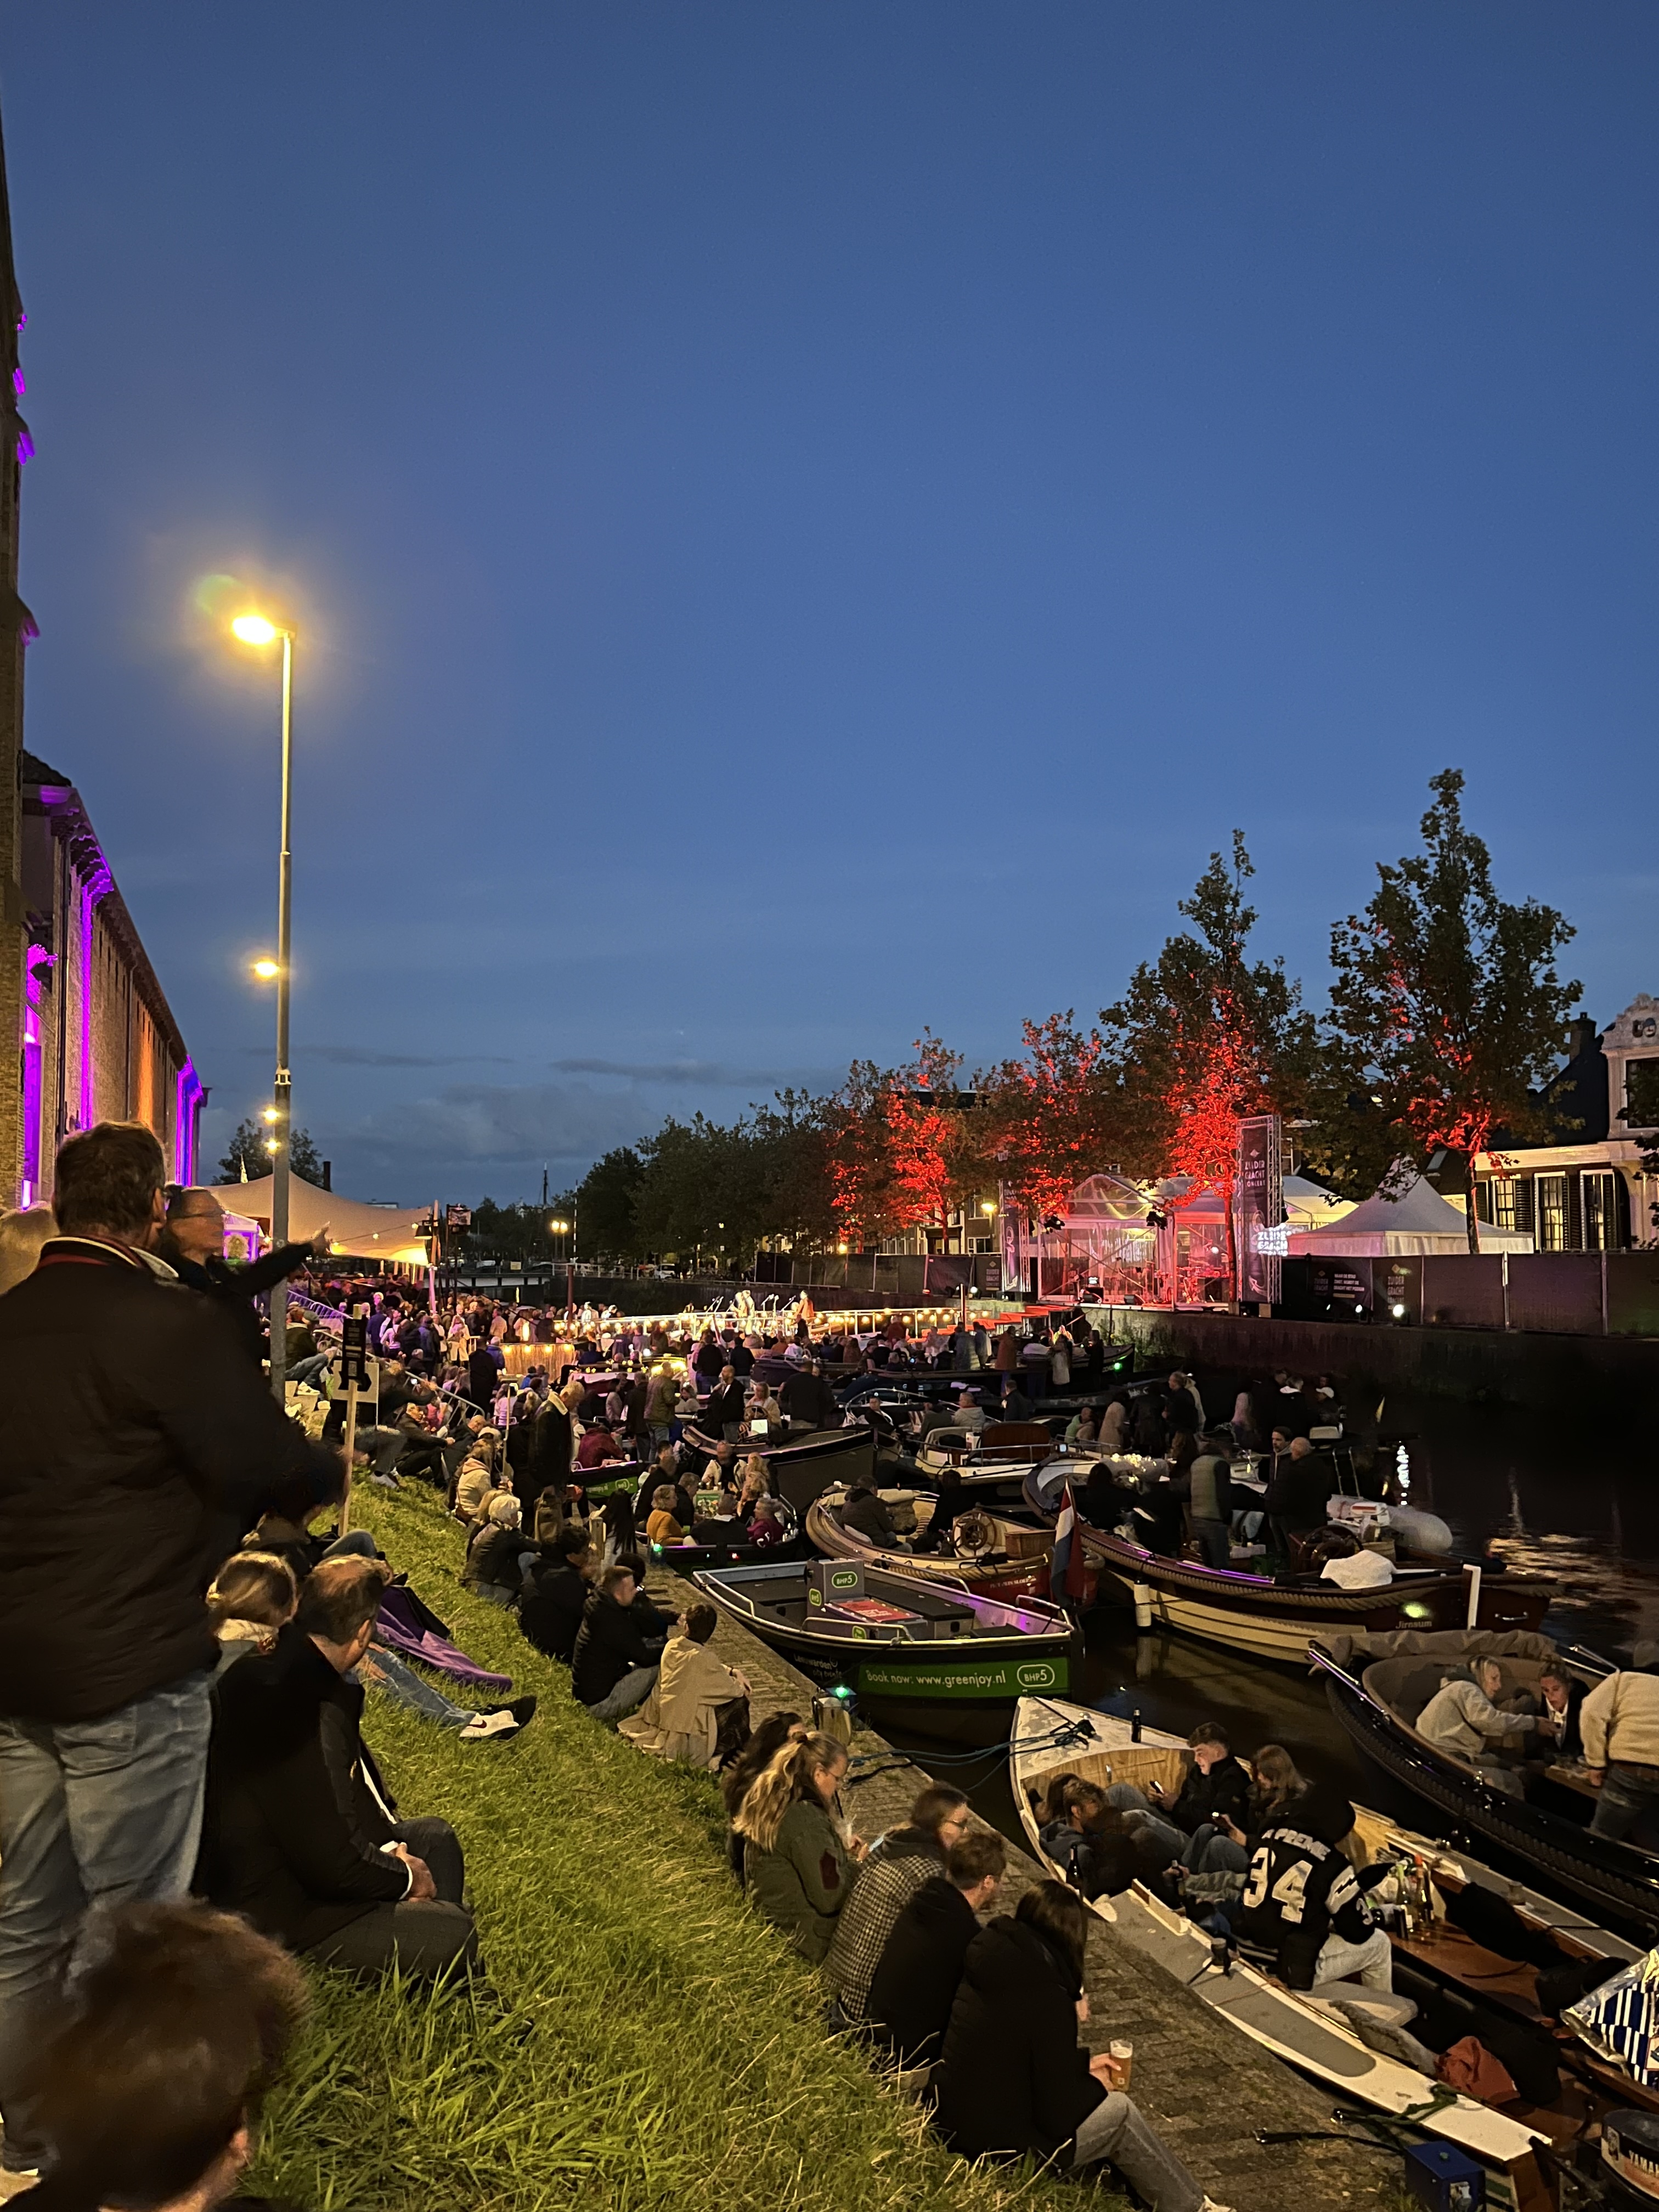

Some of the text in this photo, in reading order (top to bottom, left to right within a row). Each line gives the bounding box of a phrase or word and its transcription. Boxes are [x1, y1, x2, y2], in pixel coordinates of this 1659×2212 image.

[1245, 1160, 1265, 1170] ZUIDER
[1245, 1170, 1265, 1180] GRACHT
[1387, 1276, 1404, 1285] ZUIDER
[1387, 1286, 1404, 1295] GRACHT
[836, 1575, 853, 1585] BHP5
[1395, 1621, 1432, 1629] Jirnsum
[793, 1653, 832, 1670] Leeuwarden
[813, 1668, 823, 1679] city
[866, 1669, 1006, 1688] Book now: www.greenjoy.nl
[1024, 1669, 1047, 1682] BHP5
[1243, 1847, 1313, 1924] 34
